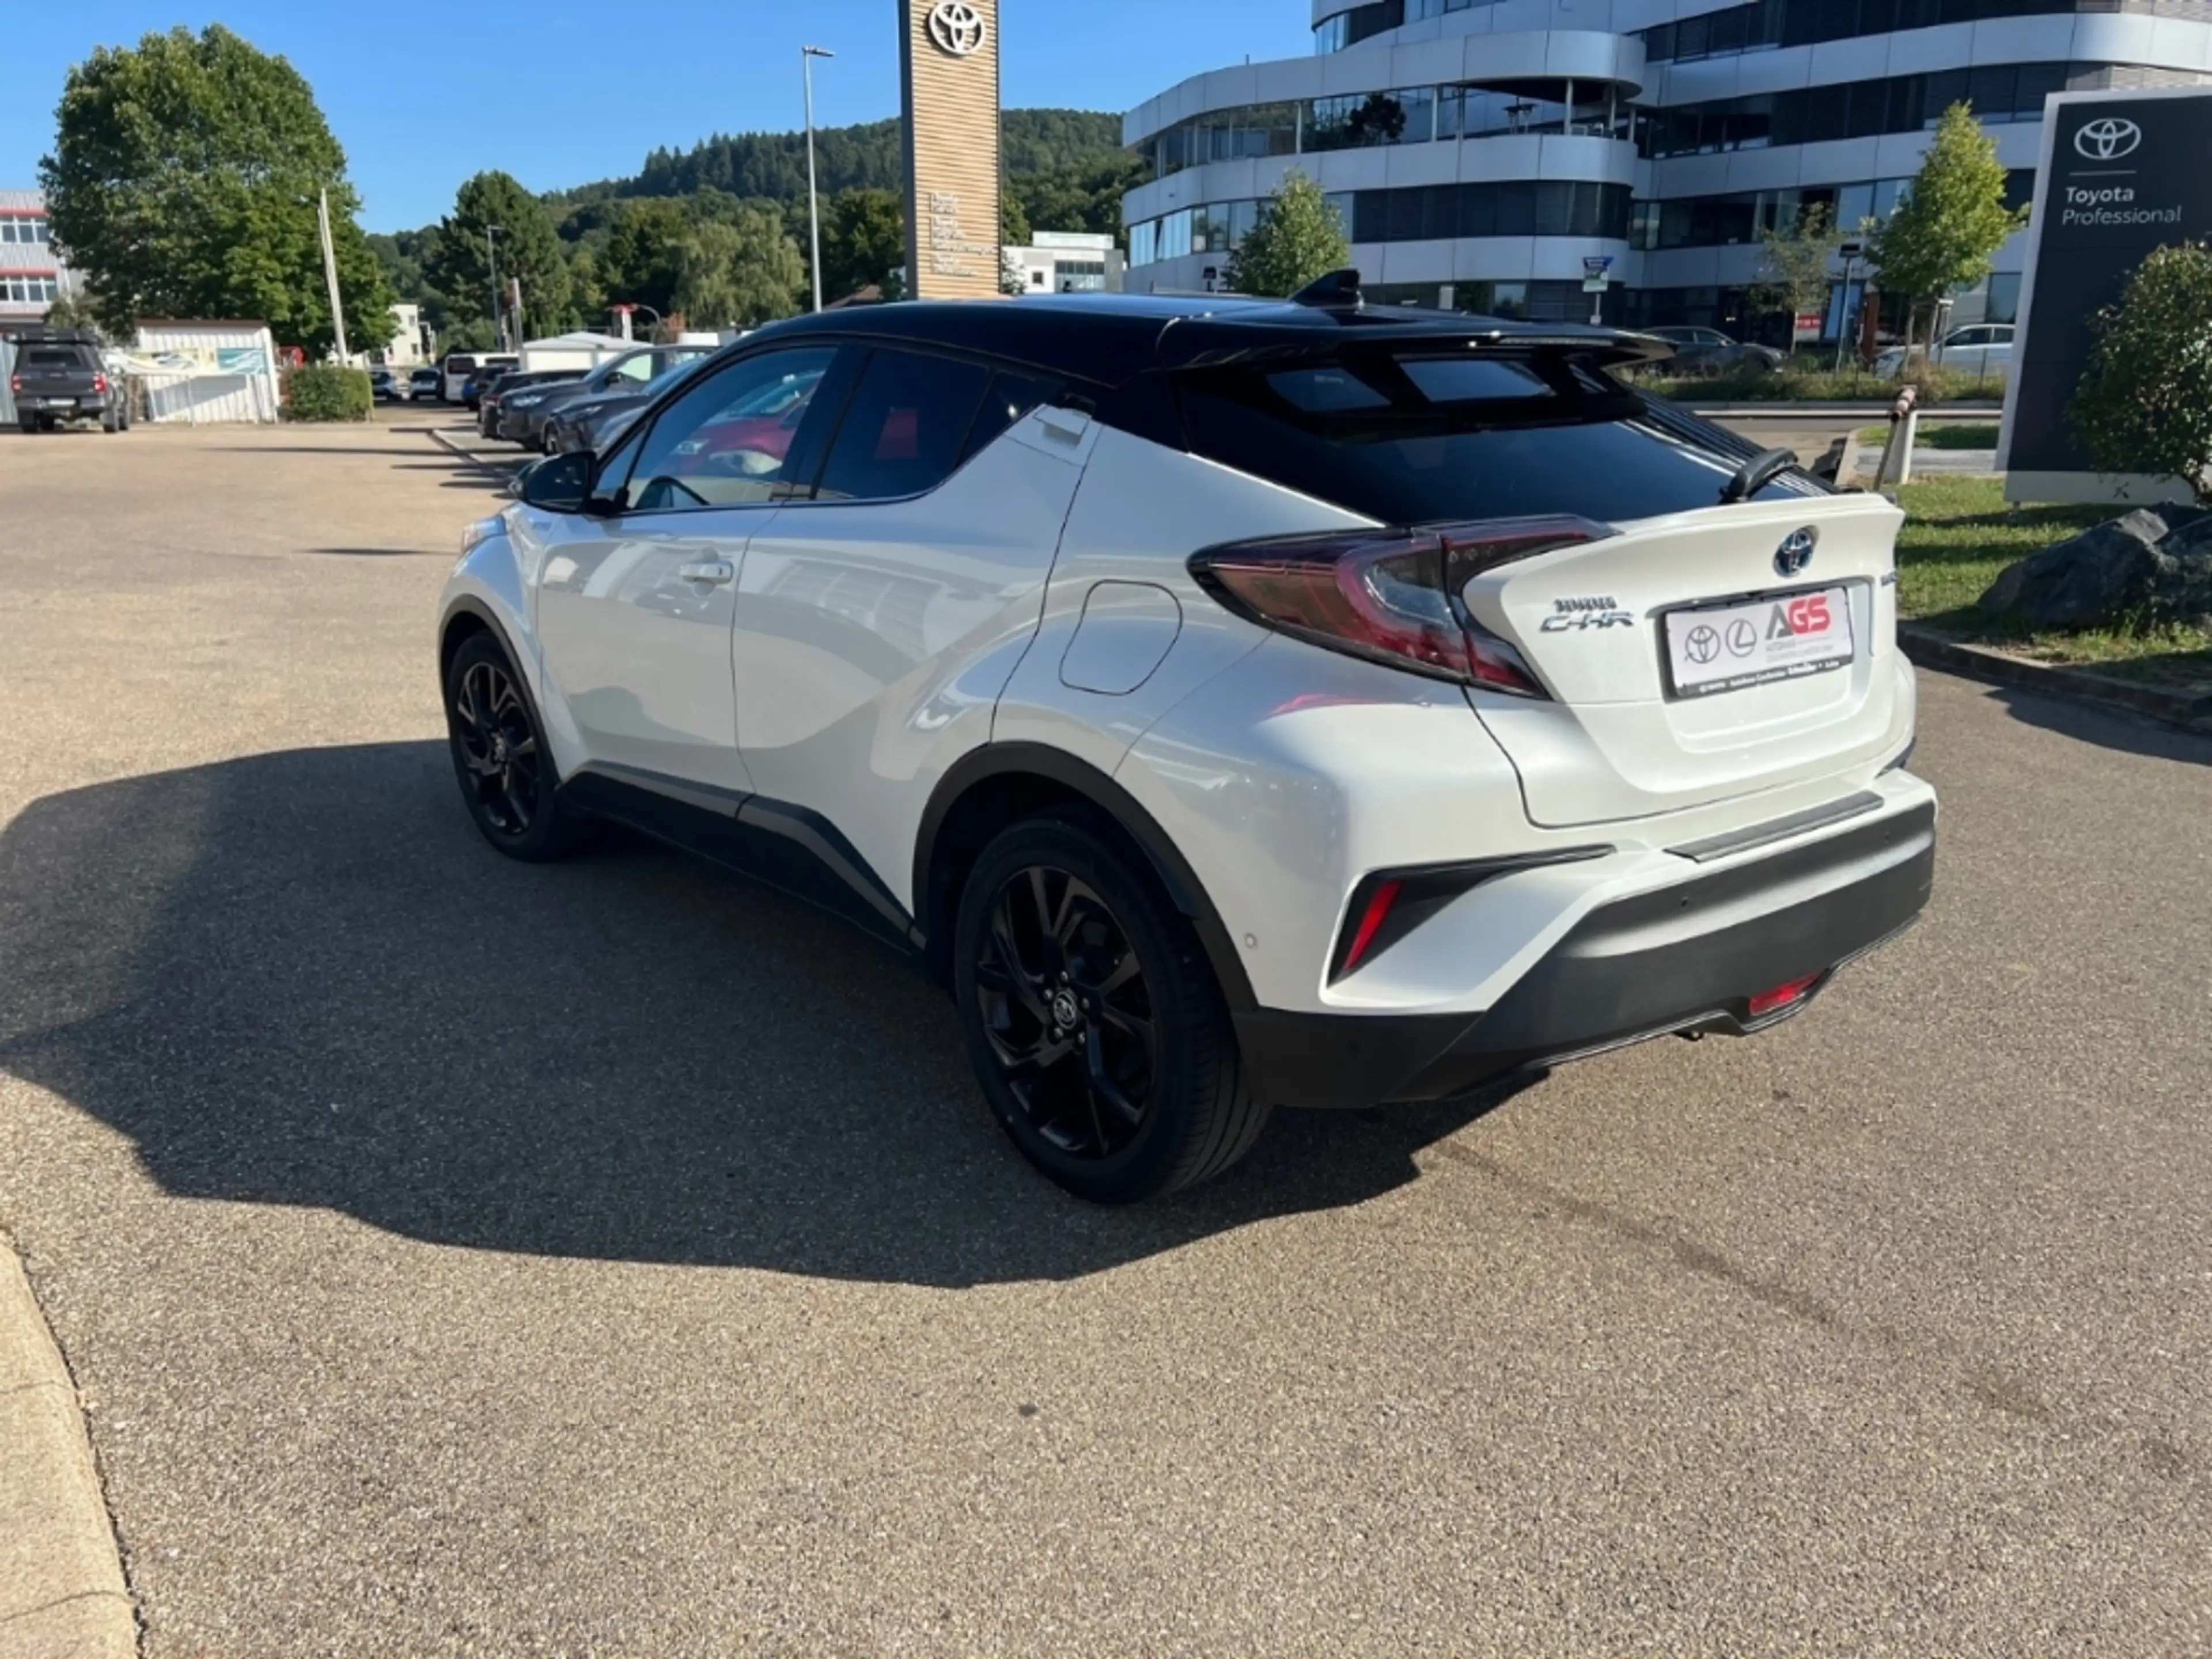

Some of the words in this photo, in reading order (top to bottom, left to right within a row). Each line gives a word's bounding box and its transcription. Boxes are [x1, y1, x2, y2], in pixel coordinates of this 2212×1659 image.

[2065, 186, 2135, 206] Toyota
[2062, 204, 2183, 226] Professional
[1540, 611, 1634, 632] C-HR
[1765, 595, 1831, 640] AGS
